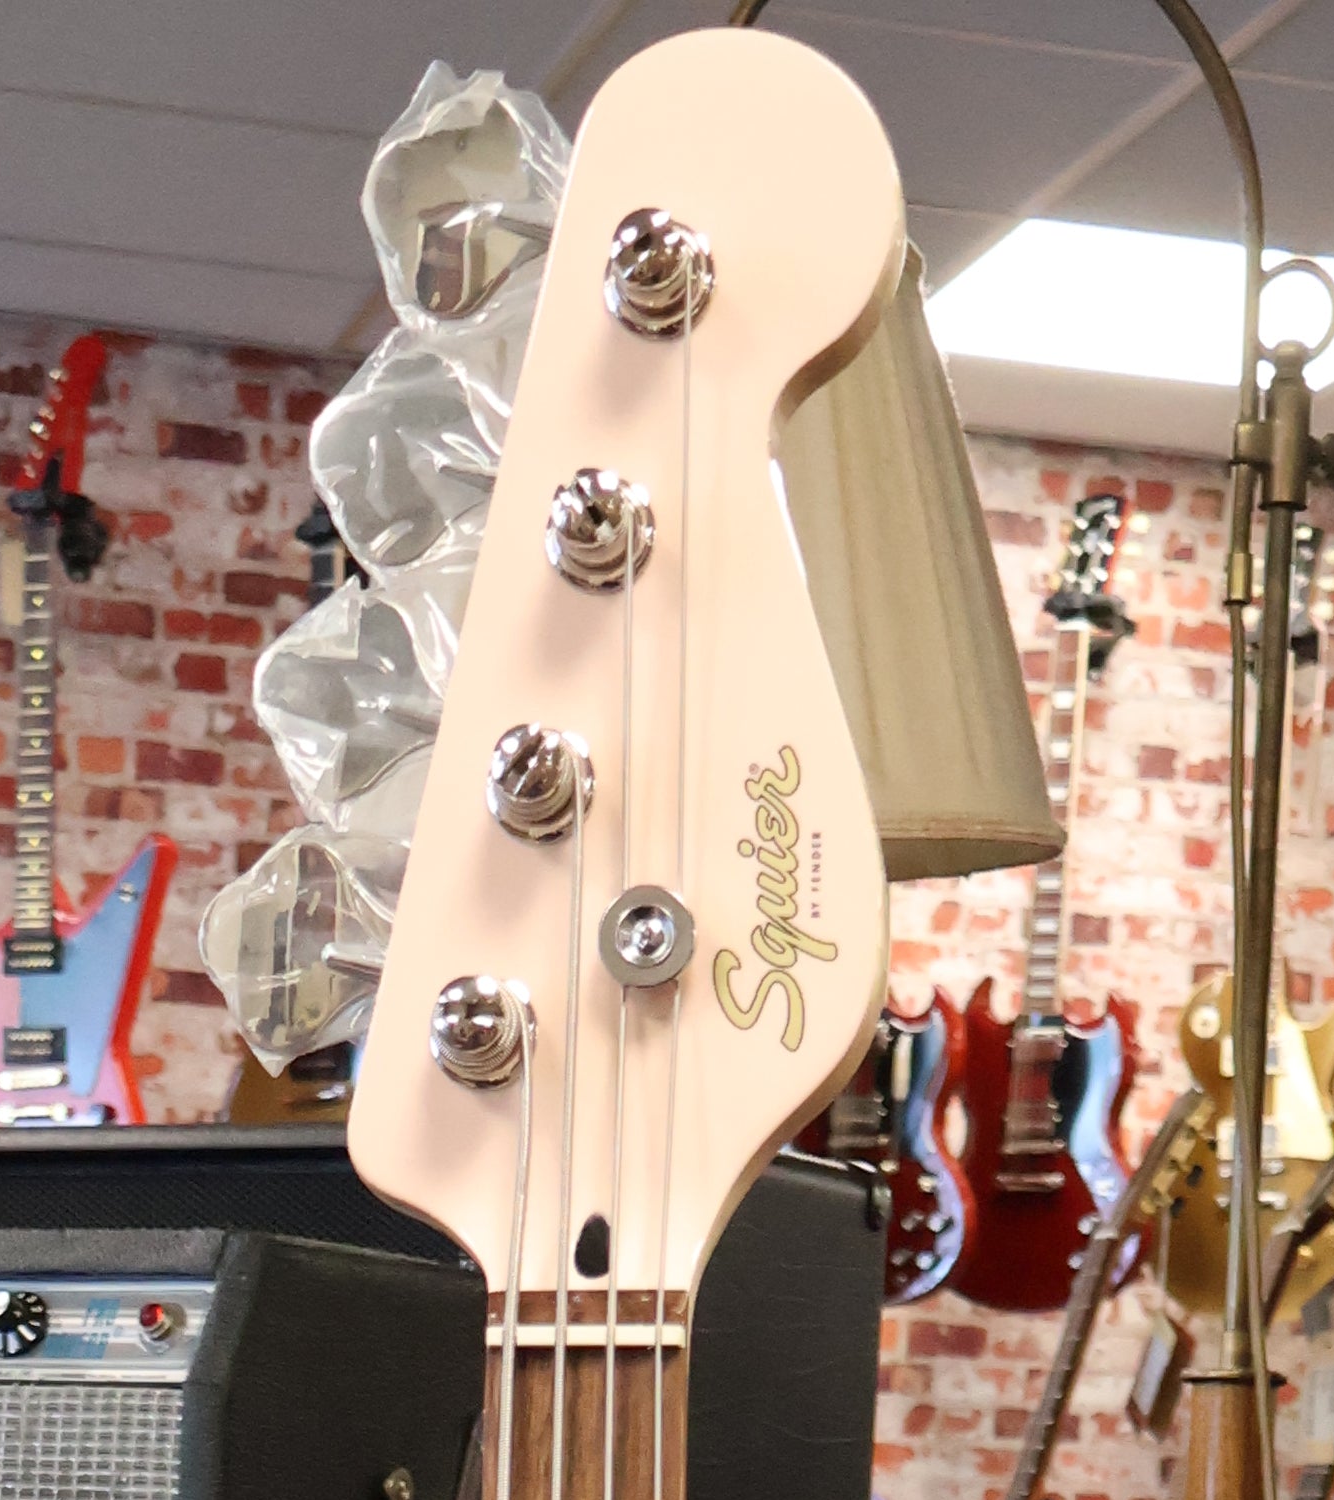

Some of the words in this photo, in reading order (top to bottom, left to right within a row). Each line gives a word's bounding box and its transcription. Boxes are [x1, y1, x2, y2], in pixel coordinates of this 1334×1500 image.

[810, 831, 822, 892] FENDER
[713, 745, 838, 1052] Squier
[810, 901, 821, 918] BY
